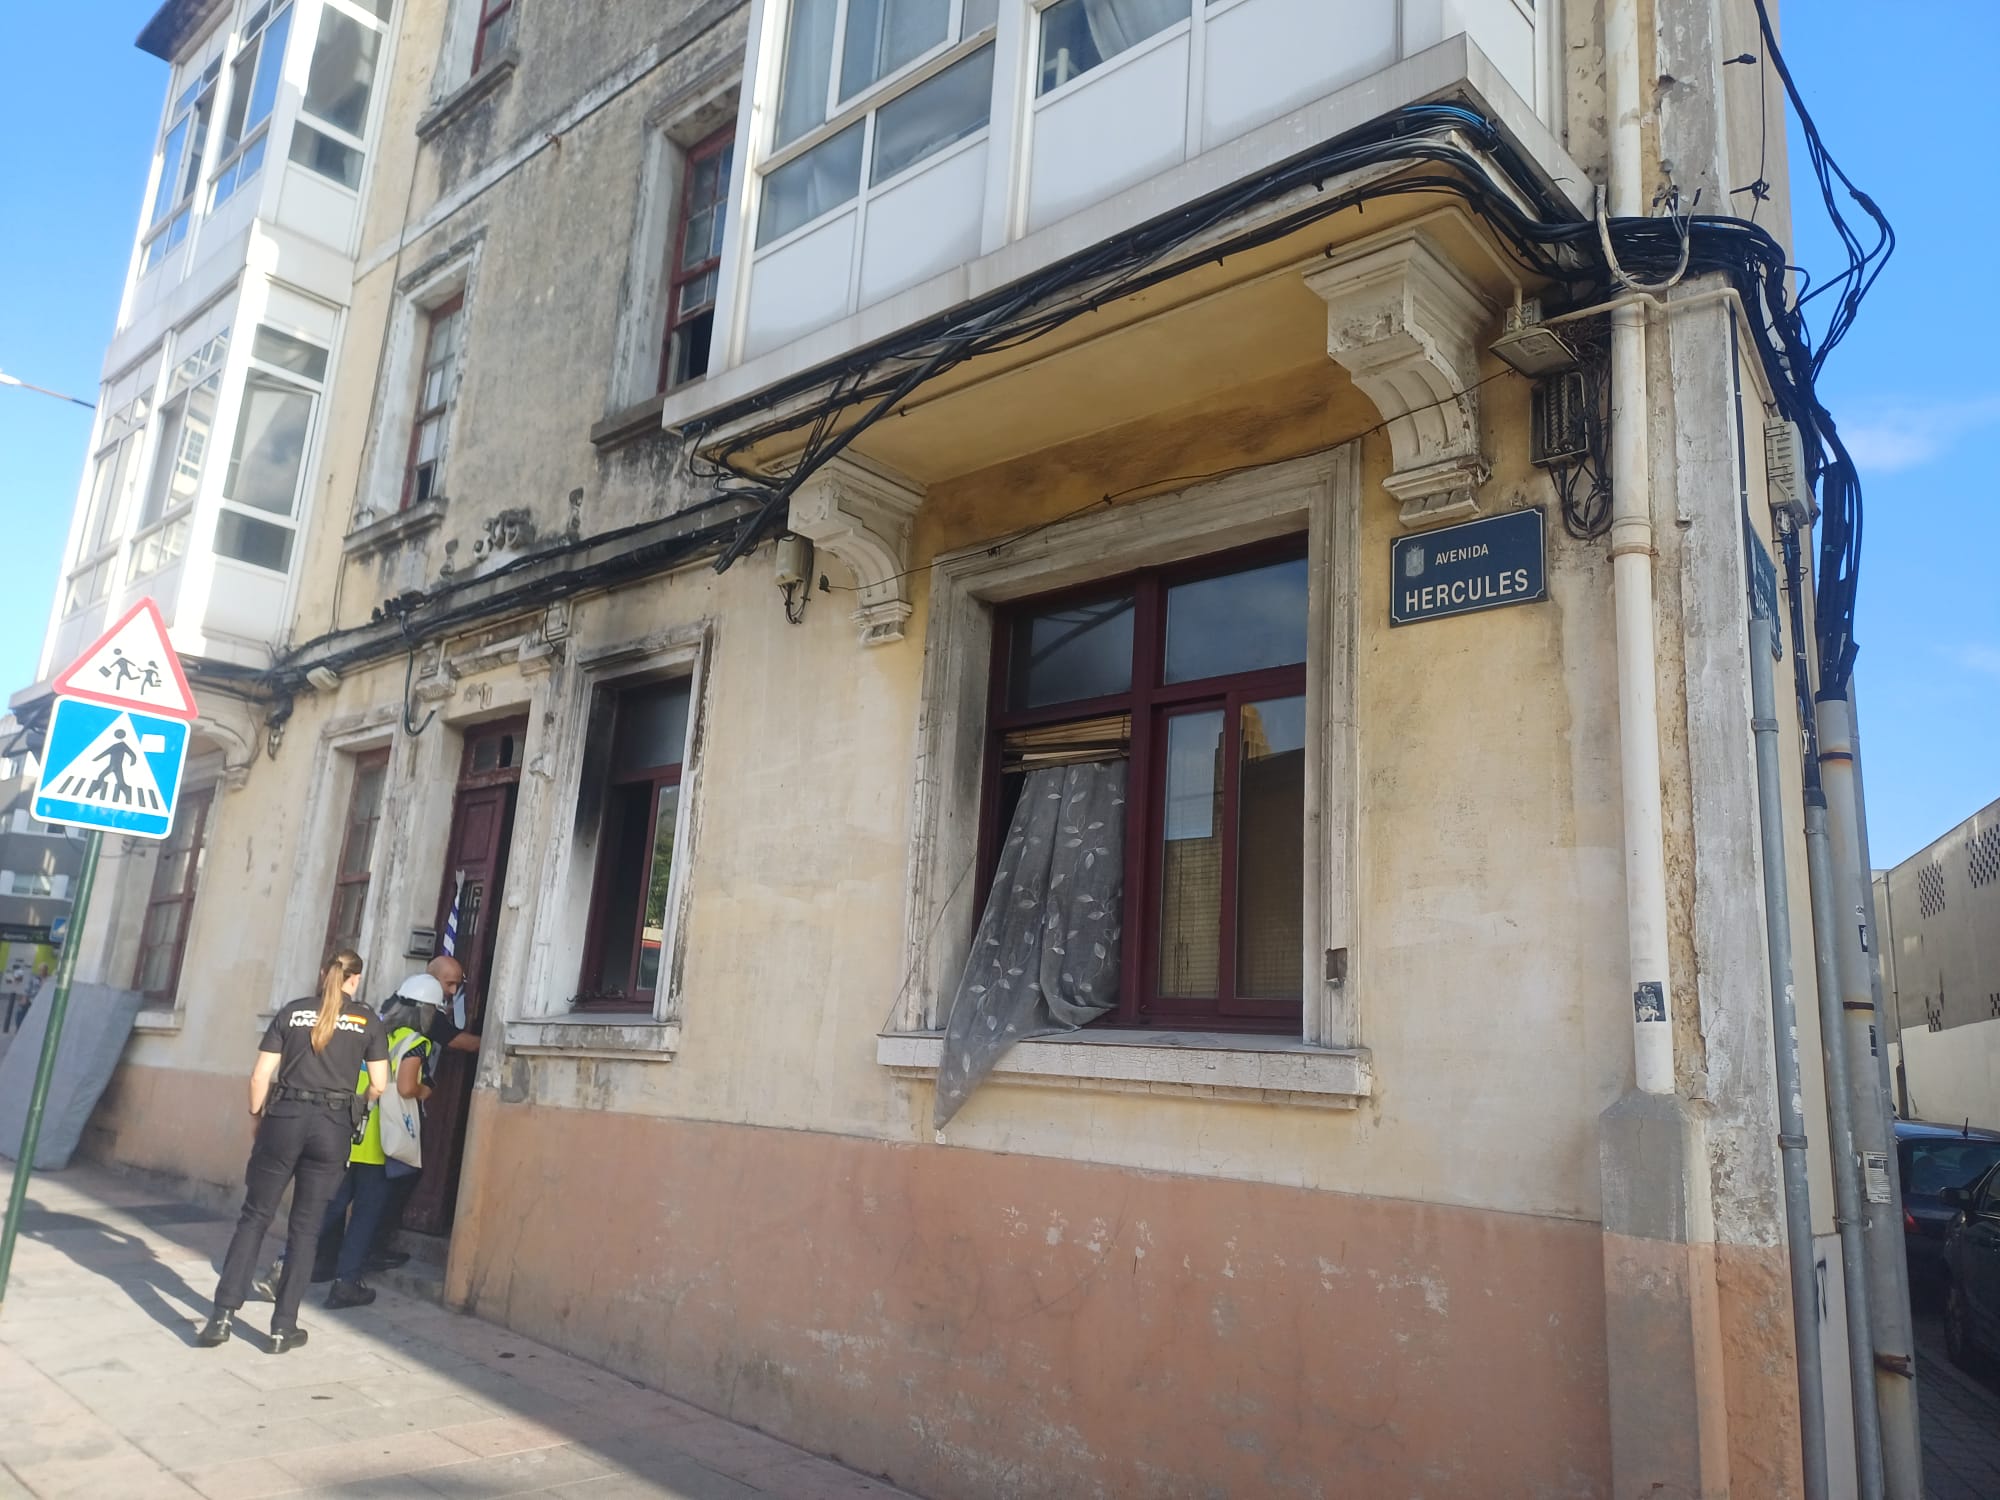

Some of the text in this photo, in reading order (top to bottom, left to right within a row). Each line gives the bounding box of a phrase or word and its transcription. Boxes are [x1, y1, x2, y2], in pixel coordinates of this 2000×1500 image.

[1435, 543, 1489, 566] AVENIDA
[1405, 568, 1528, 613] HERCULES
[289, 1018, 364, 1033] NACNAL
